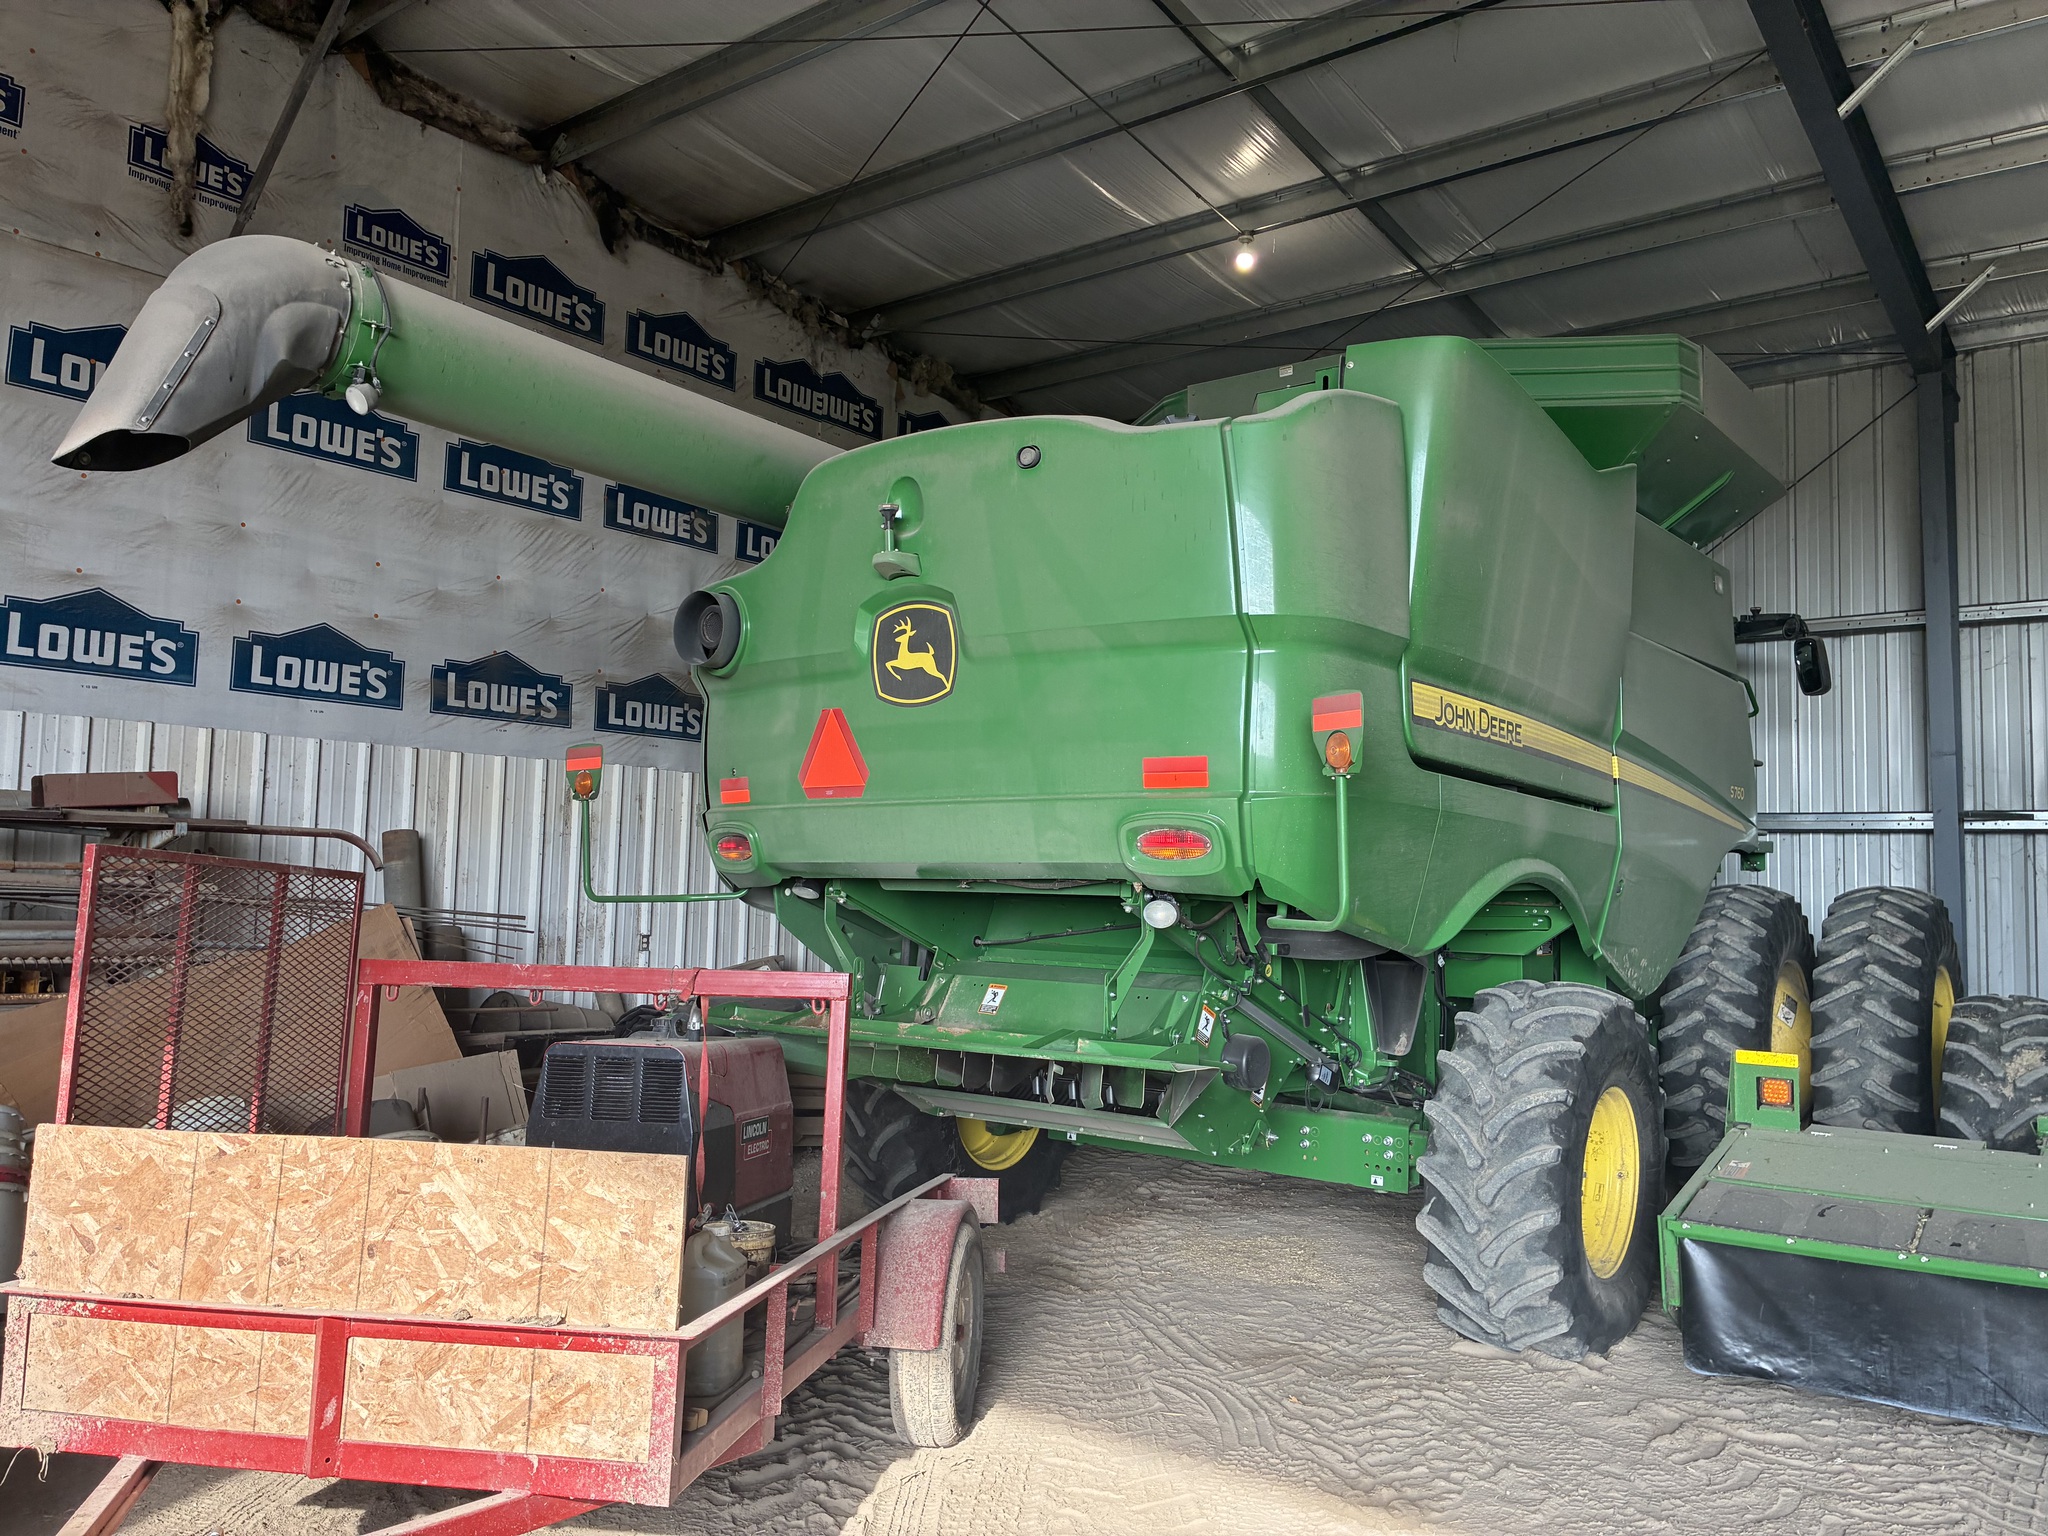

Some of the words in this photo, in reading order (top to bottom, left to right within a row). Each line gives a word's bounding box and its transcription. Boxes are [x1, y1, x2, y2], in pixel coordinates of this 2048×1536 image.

[143, 136, 243, 197] LE'S
[199, 193, 239, 214] Improvem
[344, 242, 380, 266] Improving
[382, 256, 401, 272] Home
[403, 264, 447, 289] Improvement
[356, 215, 439, 268] LOWE'S
[486, 262, 592, 333] LOWE'S
[638, 320, 726, 381] LOWE'S
[268, 401, 402, 469] LOWE'S
[460, 451, 570, 511] LOWE'S
[617, 491, 709, 546] LOWE'S
[6, 611, 177, 675] LOWE'S
[250, 645, 388, 701] LOWE'S
[447, 671, 558, 719] LOWE'S
[608, 693, 701, 736] LOWE'S
[1435, 695, 1476, 734] JOHN
[1479, 707, 1523, 745] DEERE
[743, 1120, 768, 1140] LINCOLN
[747, 1139, 770, 1156] ELECTRIC
